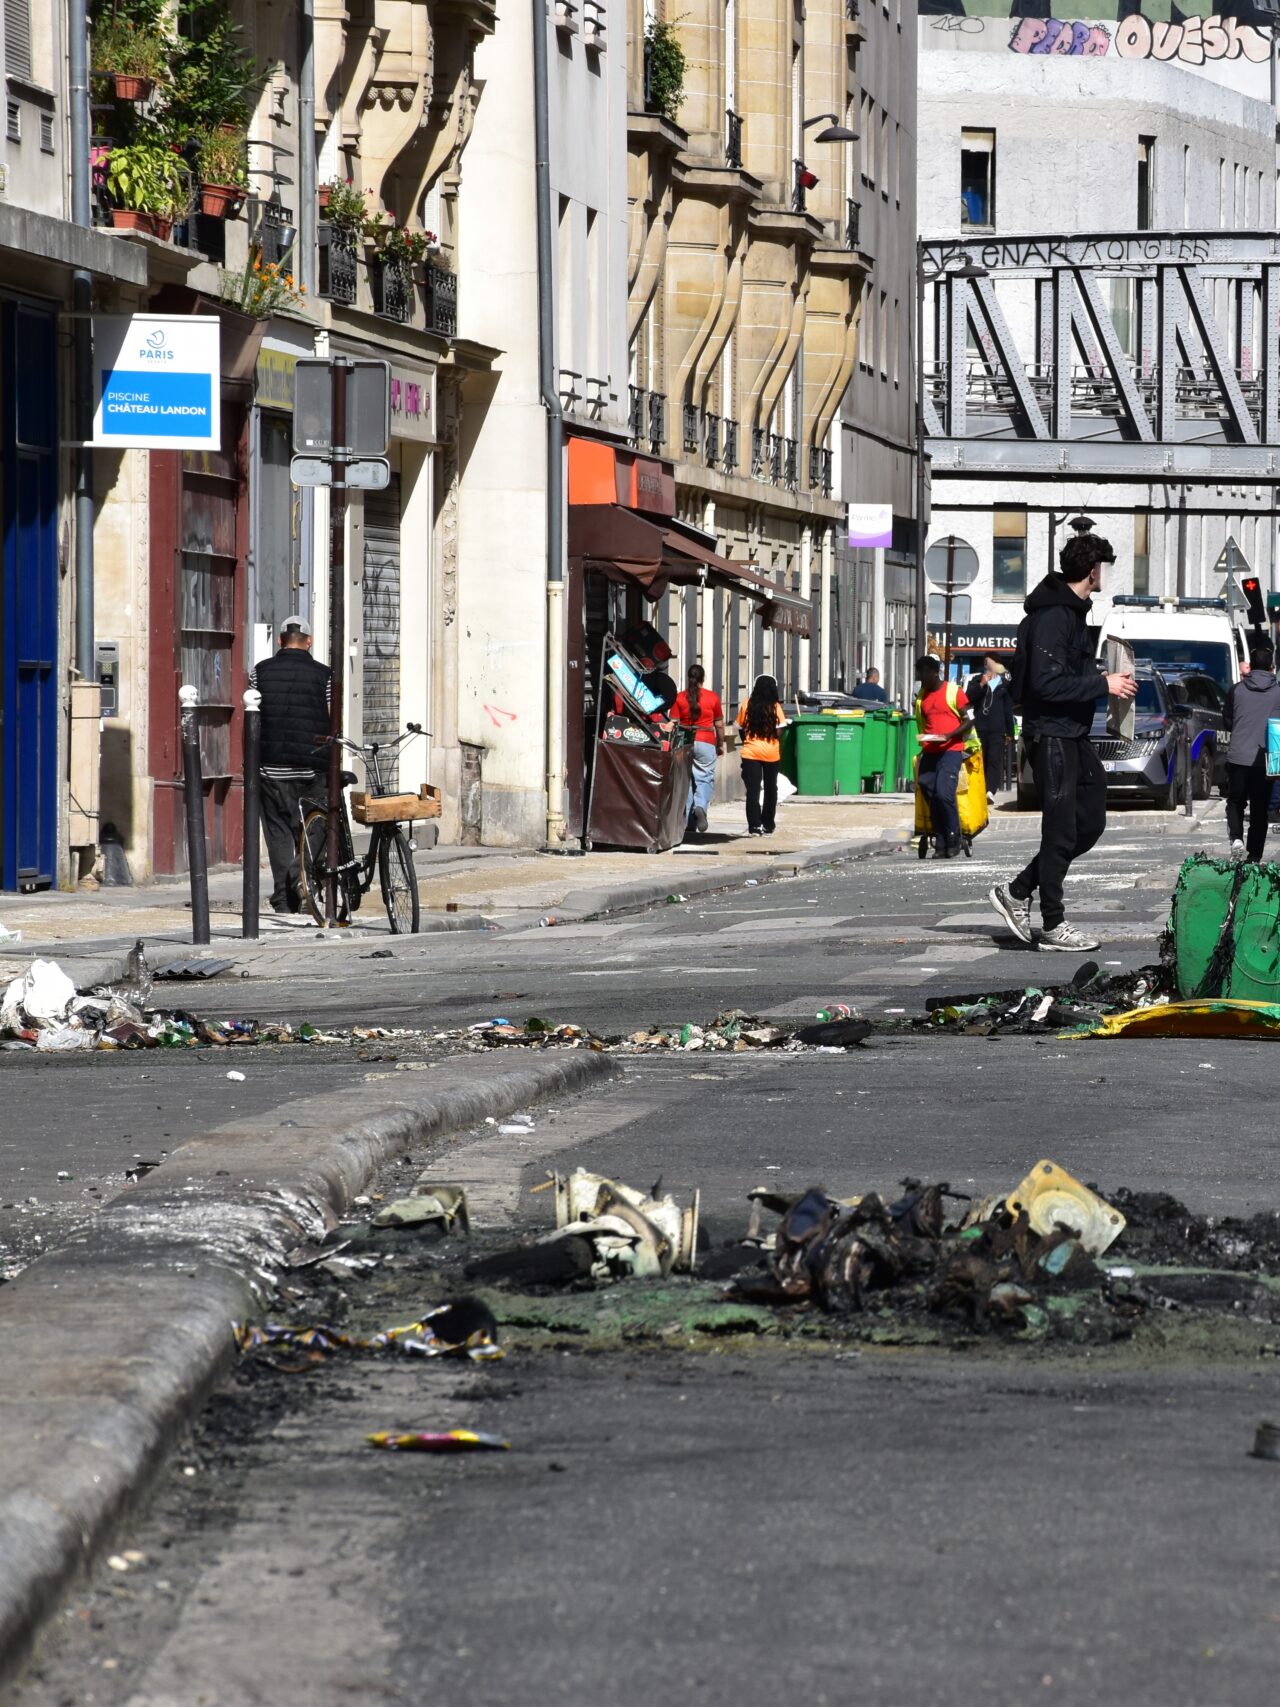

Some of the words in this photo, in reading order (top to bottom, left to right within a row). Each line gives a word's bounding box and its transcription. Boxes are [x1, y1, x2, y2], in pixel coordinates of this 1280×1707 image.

[139, 349, 175, 361] PARIS
[107, 391, 151, 402] PISCINE
[107, 403, 159, 415] CHÂTEAU
[160, 405, 207, 416] LANDON
[957, 636, 975, 648] DU
[1216, 729, 1232, 744] POLI
